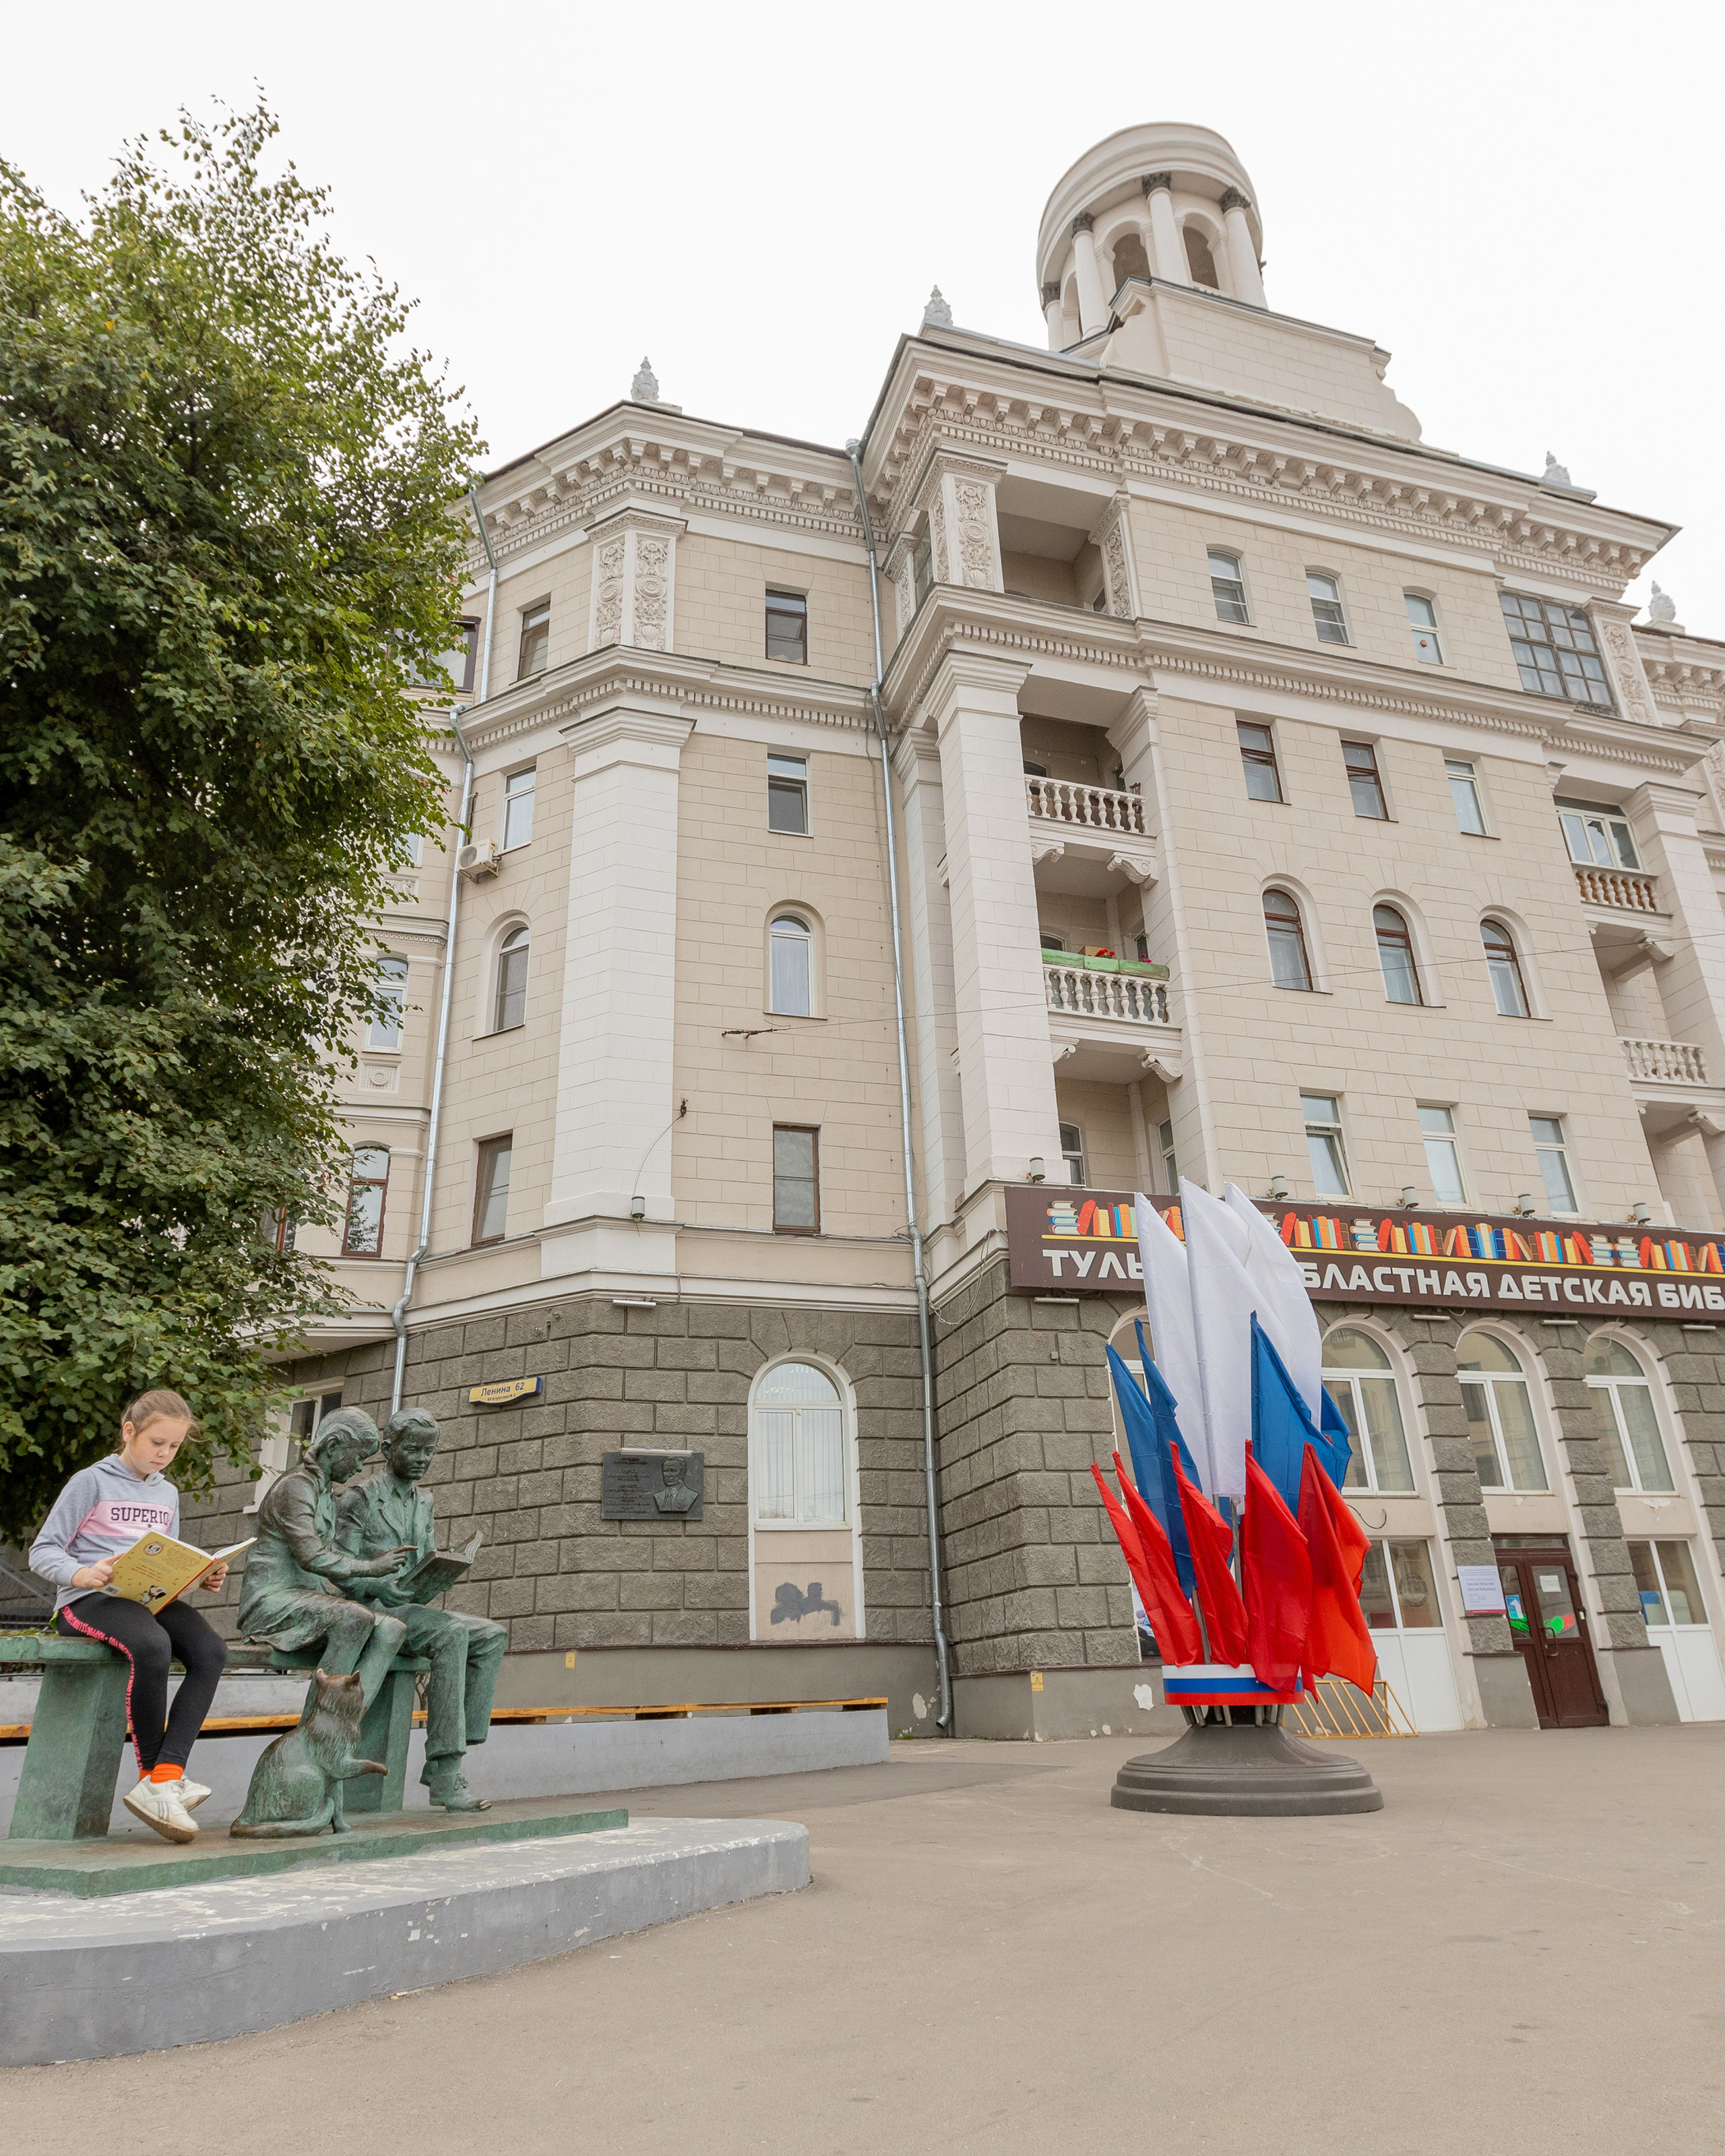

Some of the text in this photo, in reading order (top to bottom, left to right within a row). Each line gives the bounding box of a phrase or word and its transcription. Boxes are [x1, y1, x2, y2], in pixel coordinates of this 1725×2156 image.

[1042, 1248, 1143, 1280] ТУЛЬ
[1297, 1261, 1491, 1298] БЛАСТНАЯ
[1497, 1273, 1653, 1307] ДЕТСКАЯ
[480, 1381, 525, 1397] Ленина 62
